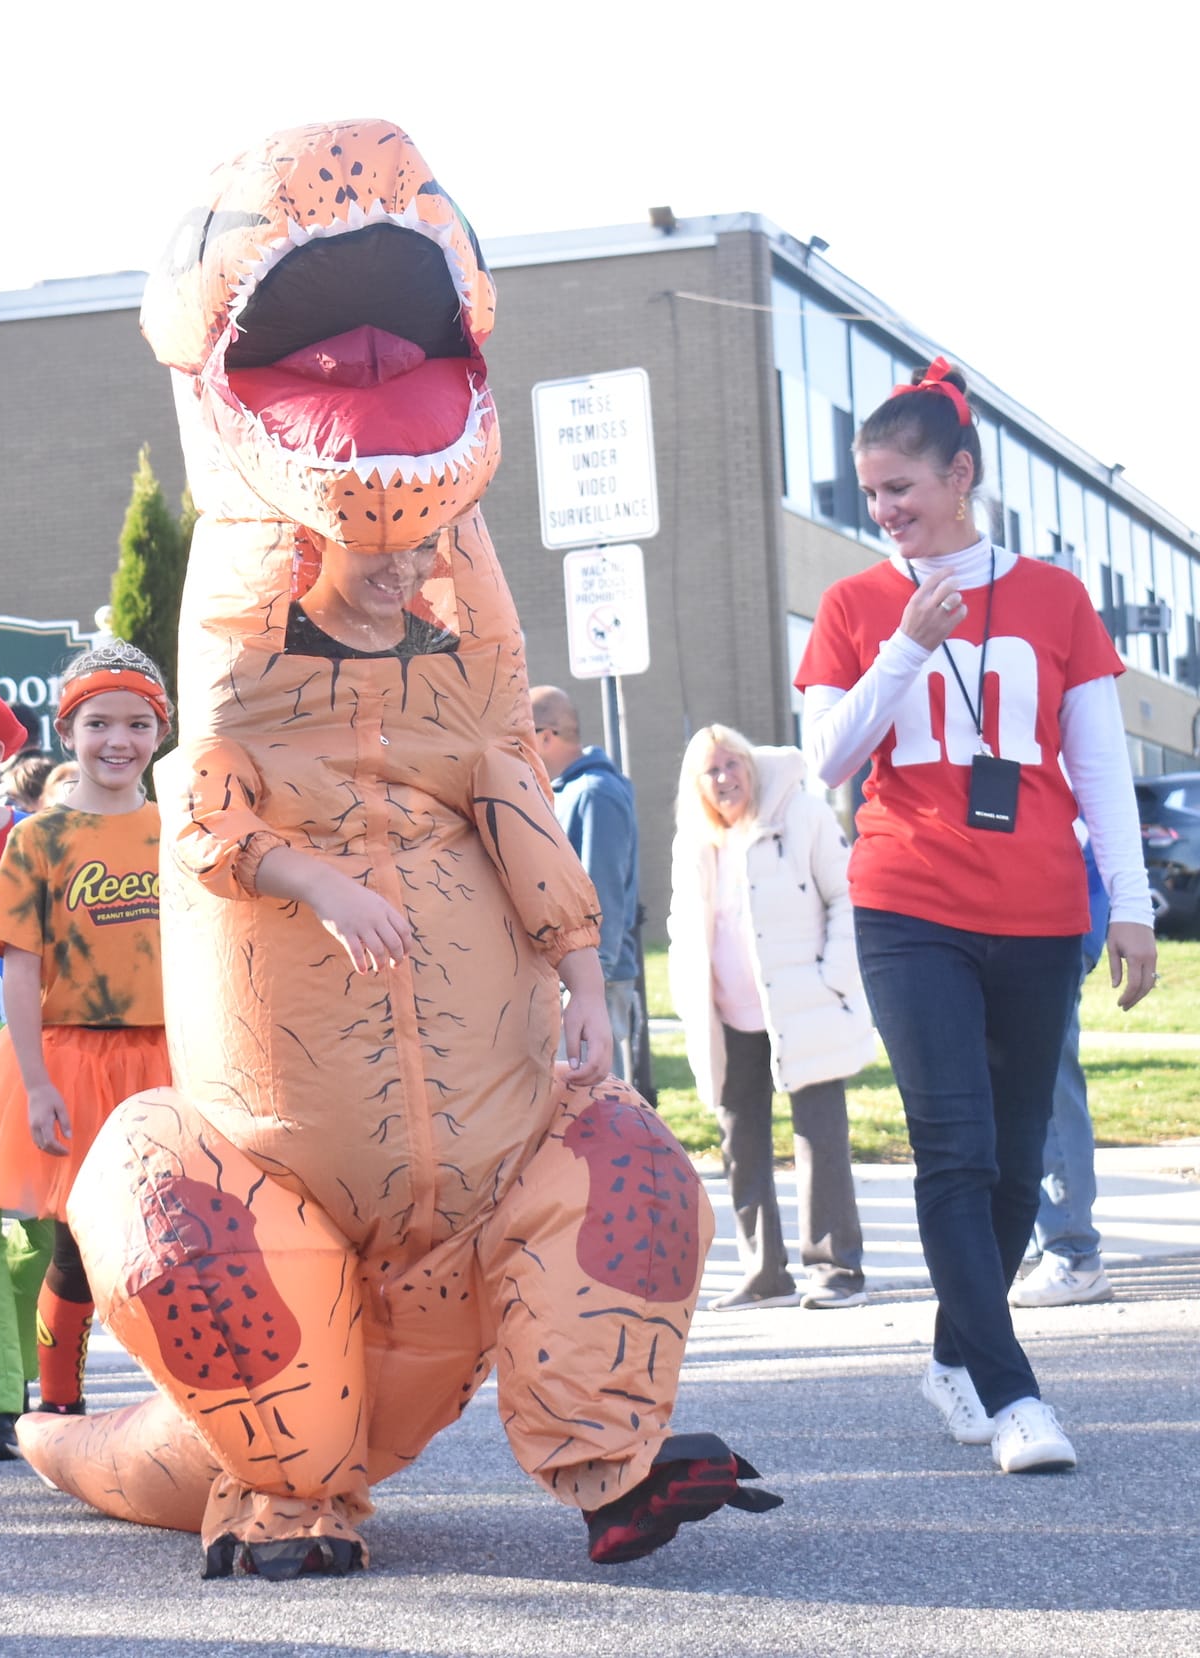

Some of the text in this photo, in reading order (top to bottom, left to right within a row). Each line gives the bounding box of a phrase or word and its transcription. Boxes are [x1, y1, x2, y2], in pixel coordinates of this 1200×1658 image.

[568, 394, 613, 417] THESE
[558, 419, 628, 445] PREMISES
[572, 448, 617, 472] UNDER
[577, 475, 616, 497] VIDEO
[549, 498, 649, 529] SURVEILLANCE
[581, 562, 625, 577] WALN
[575, 588, 633, 604] PROHIBI
[96, 911, 125, 921] PEANUT
[125, 907, 150, 918] BUTTER
